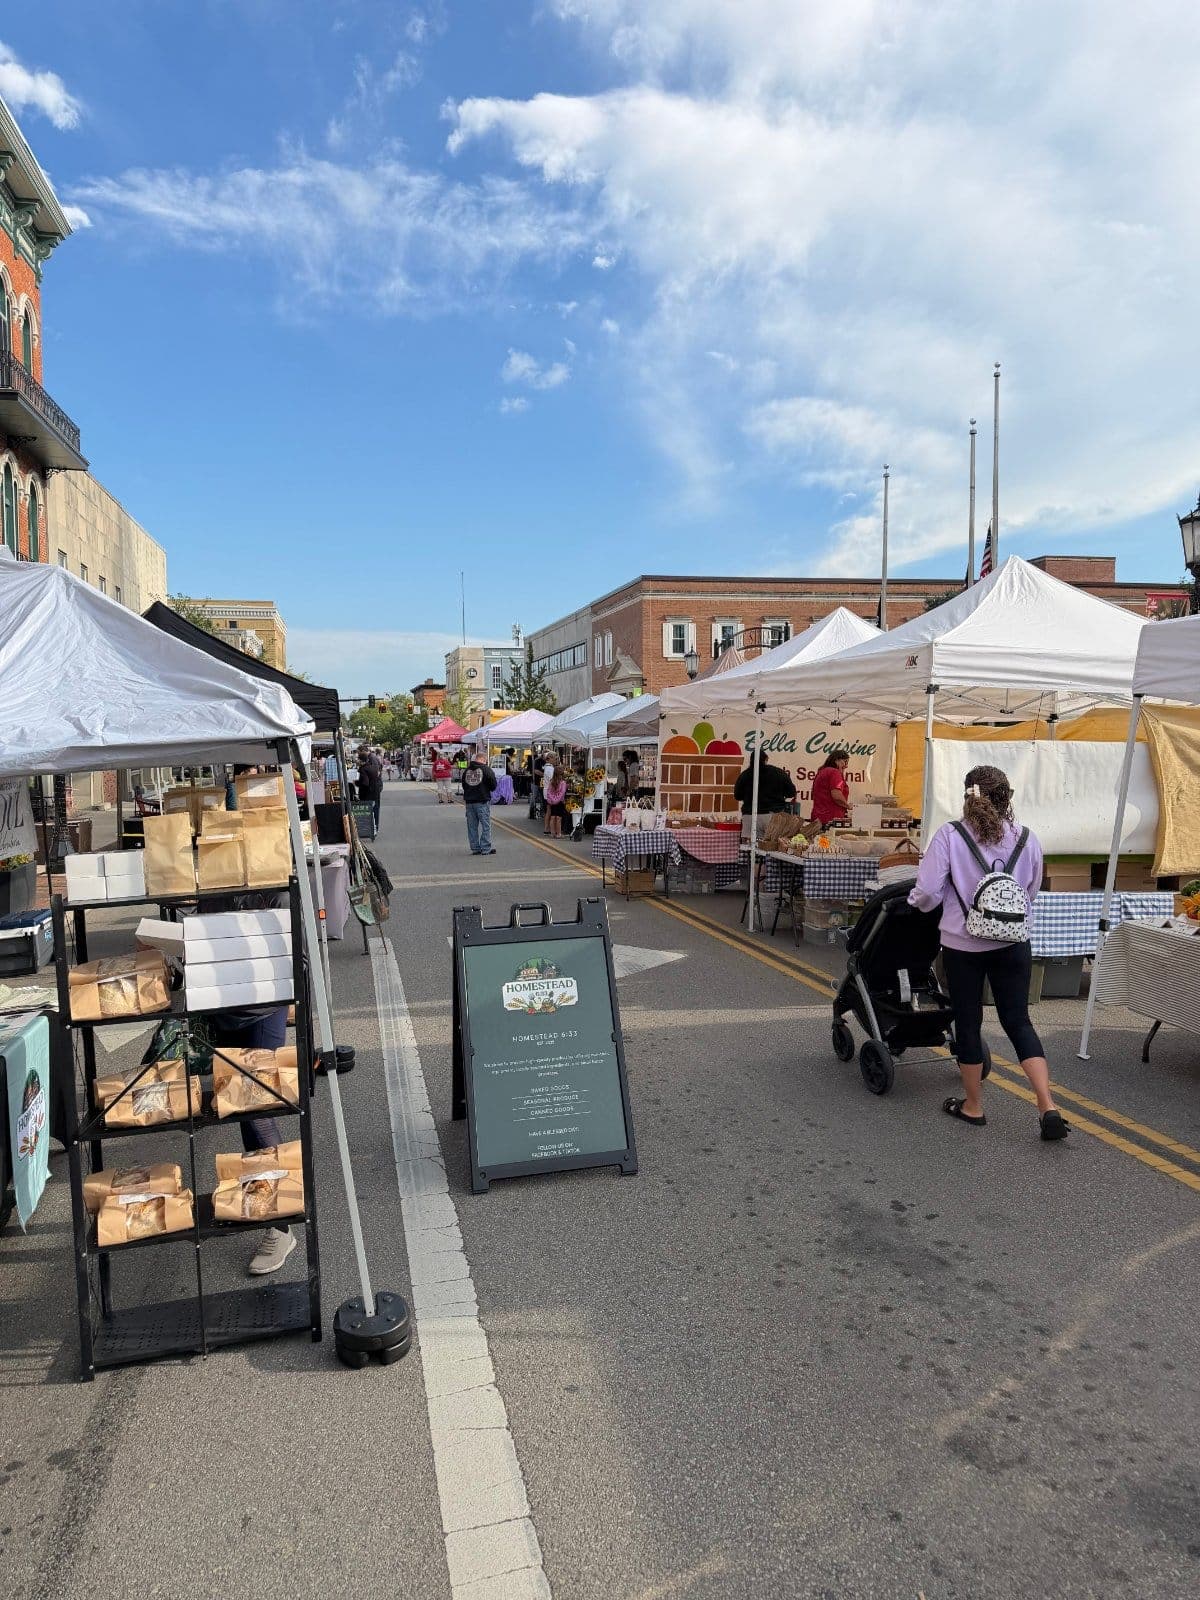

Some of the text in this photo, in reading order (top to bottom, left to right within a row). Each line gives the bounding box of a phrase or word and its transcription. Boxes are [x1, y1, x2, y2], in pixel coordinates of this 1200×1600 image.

[744, 730, 877, 756] Bella Cuisine
[796, 766, 865, 783] Senal
[506, 979, 574, 993] HOMESTEAD
[512, 1030, 578, 1042] HOMESTEAD 6:33
